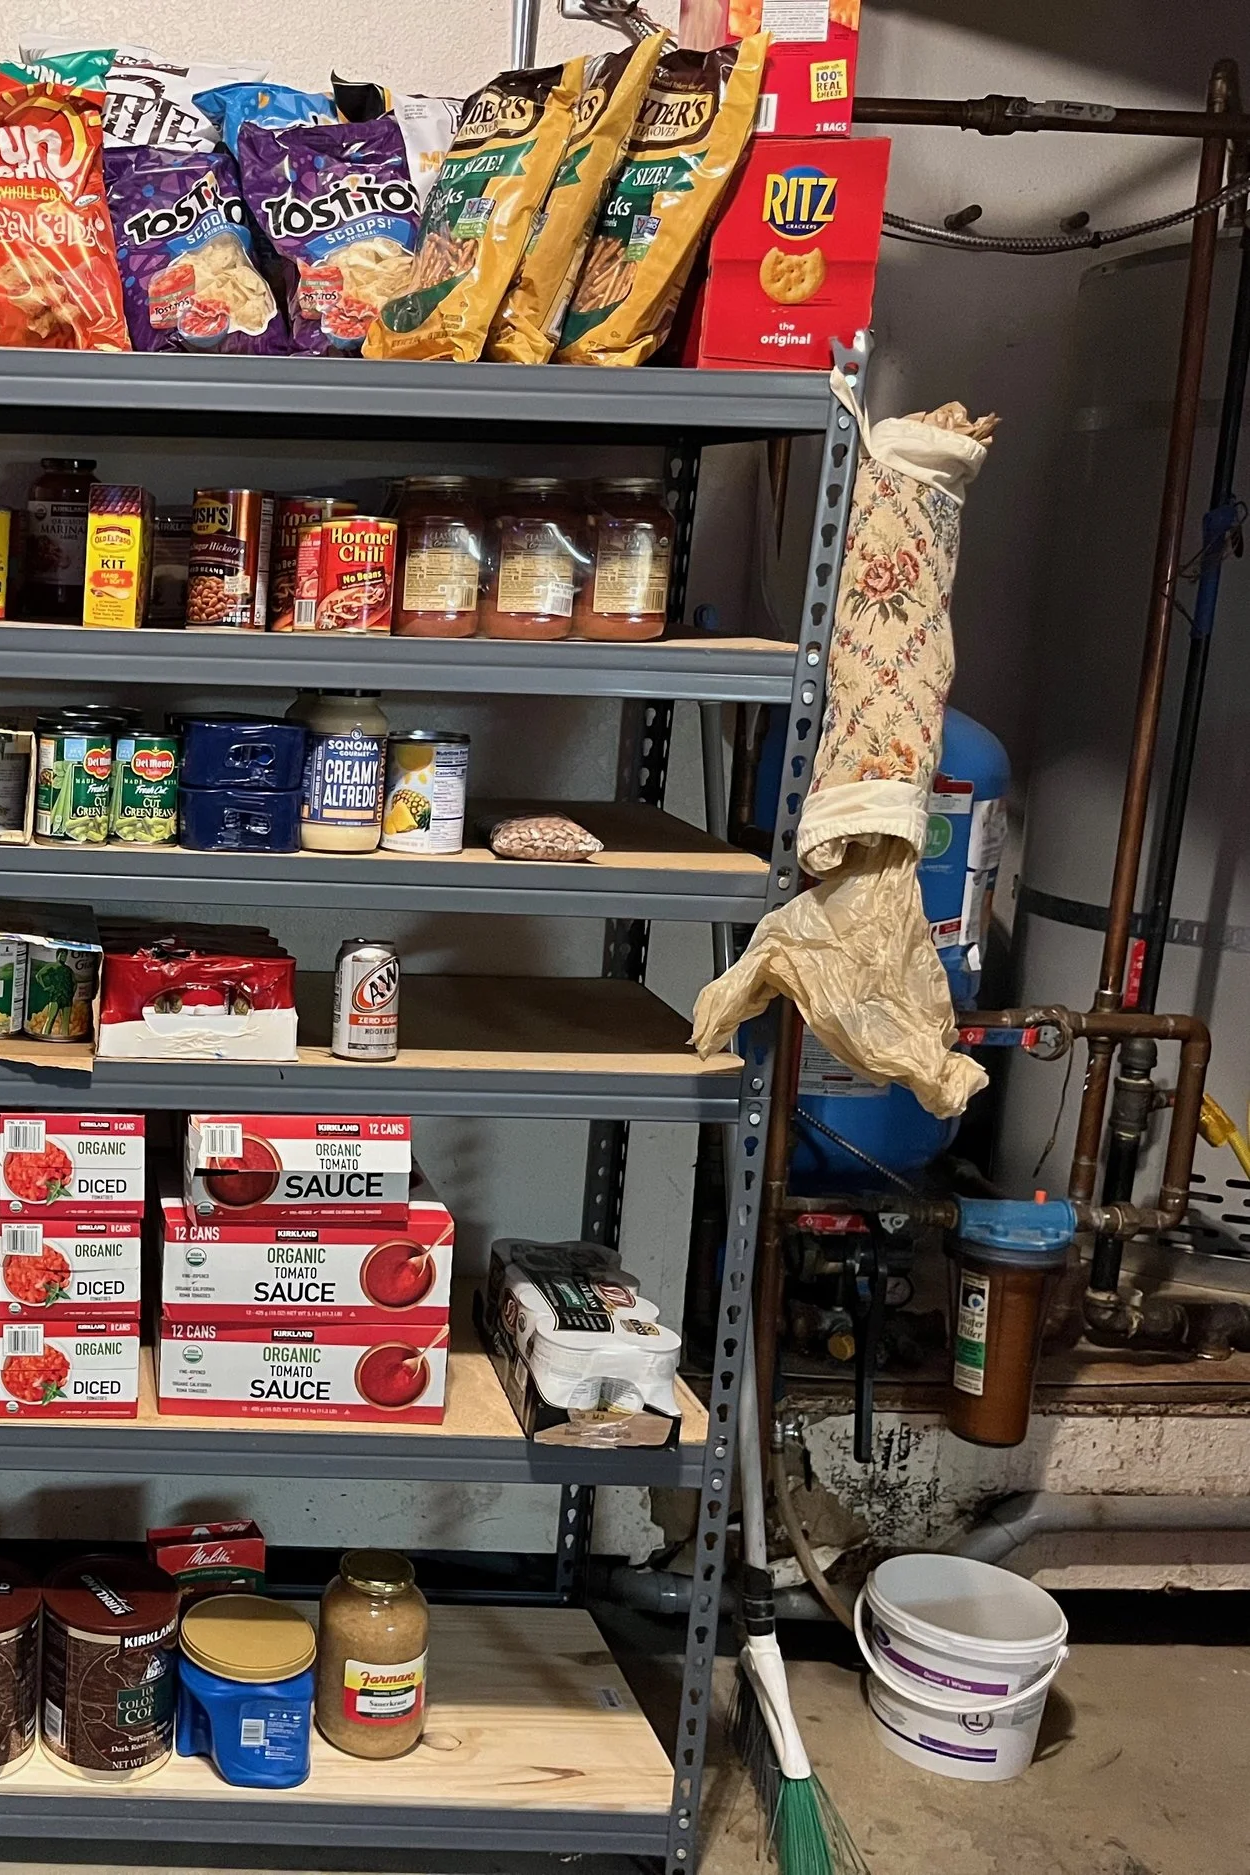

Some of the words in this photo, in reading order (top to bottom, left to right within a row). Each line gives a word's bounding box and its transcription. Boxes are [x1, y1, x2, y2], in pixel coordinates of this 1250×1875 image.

[816, 71, 843, 82] 100%
[816, 81, 841, 92] REAL
[816, 90, 842, 99] CHEESE
[815, 123, 821, 131] 2
[823, 122, 847, 131] BAGS
[461, 154, 506, 177] SIZE!
[632, 166, 674, 186] SIZE!
[762, 173, 838, 225] RITZ
[324, 217, 392, 245] SCOOPS!
[778, 322, 795, 330] the
[760, 333, 812, 347] original
[95, 536, 106, 544] OLD
[107, 535, 115, 543] EL
[115, 535, 131, 546] PASO
[331, 527, 393, 545] Hormel
[209, 541, 240, 556] Hickory
[339, 545, 385, 562] Chili
[101, 559, 127, 569] KIT
[200, 565, 224, 575] BEANS
[343, 574, 355, 584] No
[357, 570, 382, 582] Beans
[327, 739, 379, 751] SONOMA
[87, 757, 99, 766] Del
[135, 758, 148, 767] Del
[149, 759, 173, 768] Monte
[324, 758, 378, 785] CREAMY
[134, 784, 154, 795] Fresh
[322, 785, 377, 808] ALFREDO
[142, 797, 161, 807] CUT
[76, 805, 102, 817] GREEN
[124, 805, 151, 817] GREEN
[358, 1016, 380, 1024] ZERO
[118, 1122, 136, 1131] CANS
[317, 1124, 359, 1132] KIRKLAND
[368, 1123, 379, 1134] 12
[380, 1123, 404, 1135] CANS
[77, 1141, 126, 1155] ORGANIC
[315, 1143, 362, 1157] ORGANIC
[320, 1158, 359, 1171] TOMATO
[78, 1179, 127, 1193] DICED
[284, 1172, 384, 1198] SAUCE
[115, 1224, 132, 1232] CANS
[174, 1226, 187, 1241] 12
[189, 1226, 220, 1241] CANS
[277, 1230, 318, 1238] KIRKLAND
[75, 1243, 123, 1257] ORGANIC
[267, 1247, 327, 1264] ORGANIC
[274, 1266, 318, 1279] TOMATO
[76, 1280, 125, 1296] DICED
[253, 1281, 337, 1303] SAUCE
[115, 1323, 131, 1331] CANS
[171, 1324, 184, 1338] 12
[186, 1324, 217, 1339] CANS
[273, 1330, 313, 1338] KIRKLAND
[75, 1342, 123, 1356] ORGANIC
[263, 1346, 322, 1363] ORGANIC
[270, 1365, 313, 1378] TOMATO
[73, 1380, 121, 1395] DICED
[249, 1379, 331, 1401] SAUCE
[184, 1545, 232, 1567] Melitta
[80, 1574, 126, 1616] KIRKLAND
[123, 1619, 177, 1649] KIRKLAND
[360, 1671, 416, 1687] Farman's
[951, 1679, 972, 1691] Wipes
[369, 1699, 407, 1707] Sauerkraut
[111, 1745, 129, 1753] Dark
[112, 1759, 129, 1769] NET
[130, 1758, 143, 1768] WT
